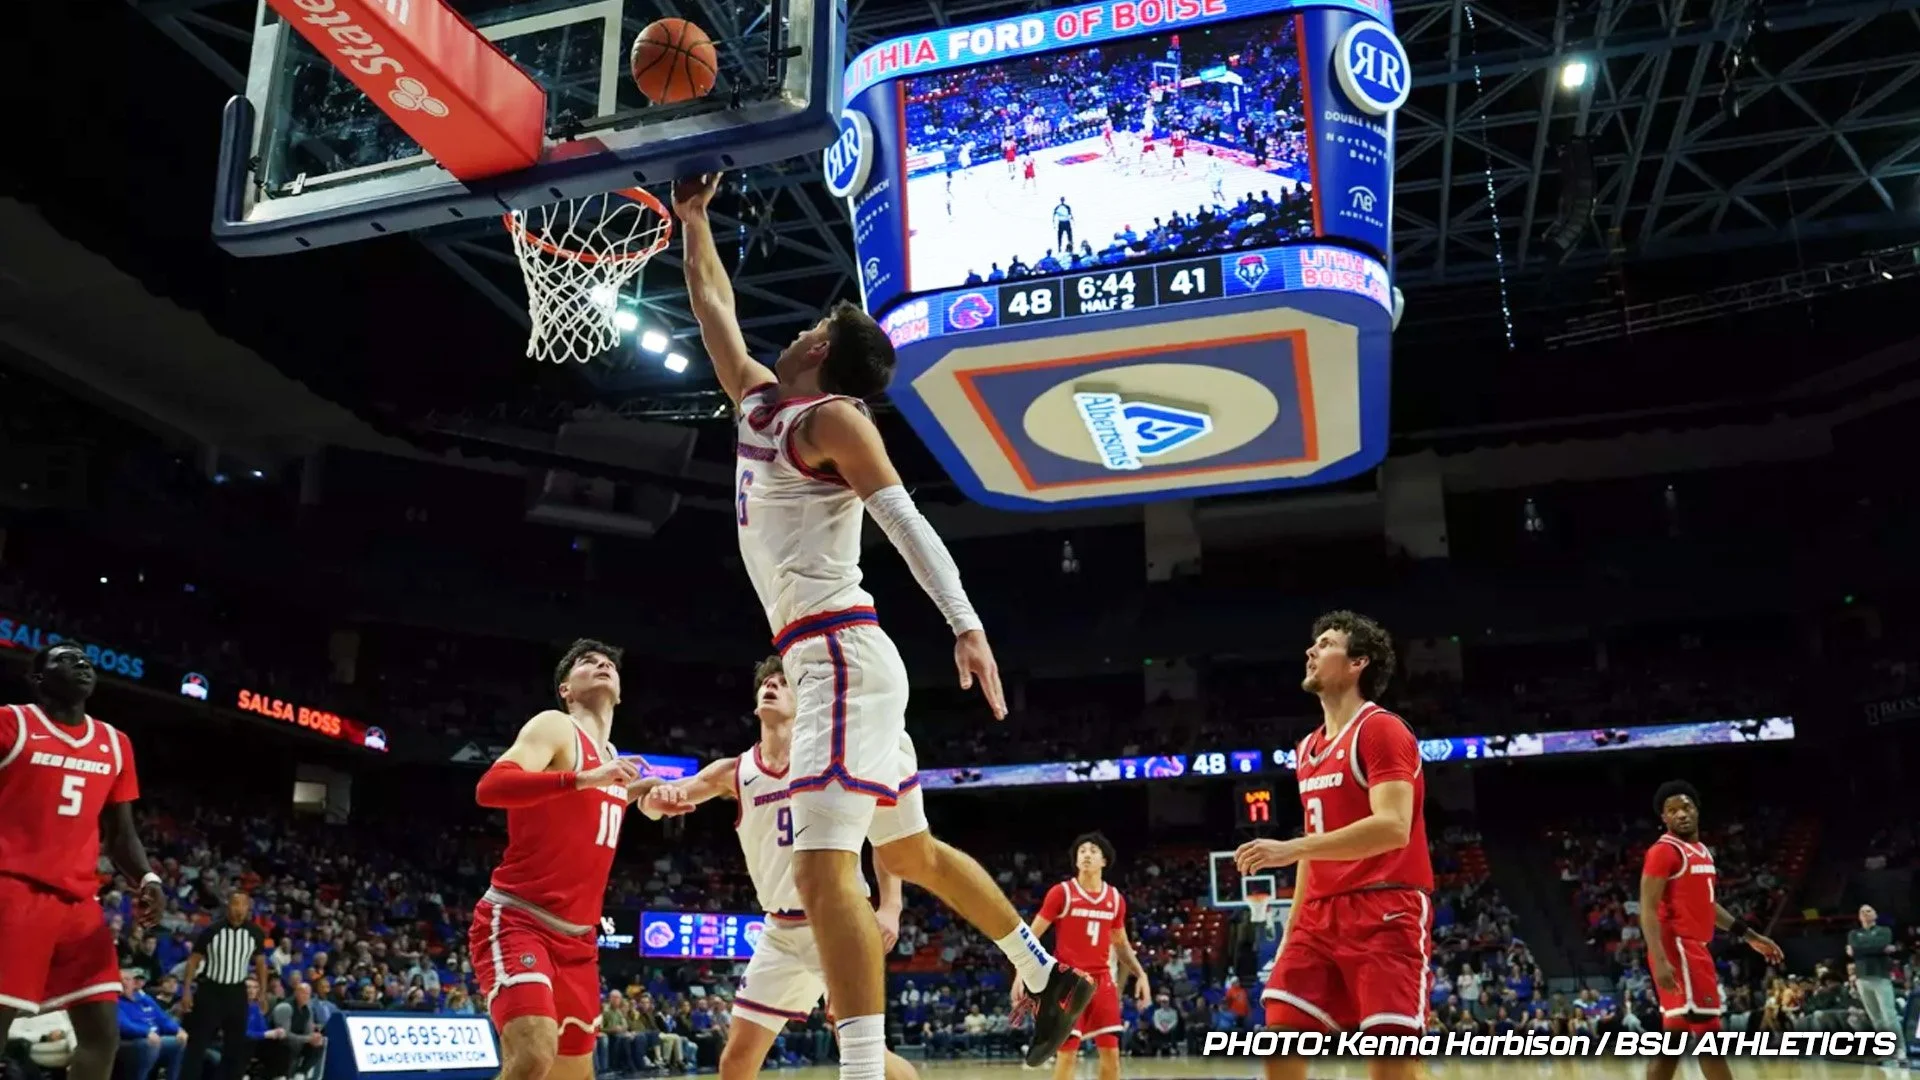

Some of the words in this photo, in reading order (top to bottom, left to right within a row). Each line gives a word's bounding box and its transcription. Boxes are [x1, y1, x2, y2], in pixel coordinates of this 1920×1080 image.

[948, 19, 1045, 60] FORD
[1055, 8, 1102, 41] OF
[1112, 0, 1228, 30] BOISE
[1324, 110, 1363, 127] DOUBLE
[1349, 149, 1377, 166] Beef
[1300, 249, 1364, 273] LITHIA
[1078, 271, 1136, 299] 6:44
[1170, 267, 1206, 295] 41
[1008, 288, 1052, 316] 48
[1080, 297, 1118, 313] HALF
[1121, 293, 1135, 310] 2
[1080, 396, 1132, 467] Albertsons
[0, 617, 64, 653] SAL
[85, 643, 145, 680] BOSS
[237, 689, 295, 722] SALSA
[298, 706, 341, 735] BOSS
[30, 751, 64, 767] NEW
[62, 756, 111, 775] MEXICO
[1192, 753, 1226, 774] 48
[1273, 749, 1297, 765] 6:4
[57, 774, 86, 817] 5
[595, 800, 622, 849] 10
[778, 806, 794, 847] 9
[1086, 920, 1101, 947] 4
[361, 1025, 483, 1046] 208-695-2121
[367, 1051, 487, 1065] IDAHOEVENTRENT.COM
